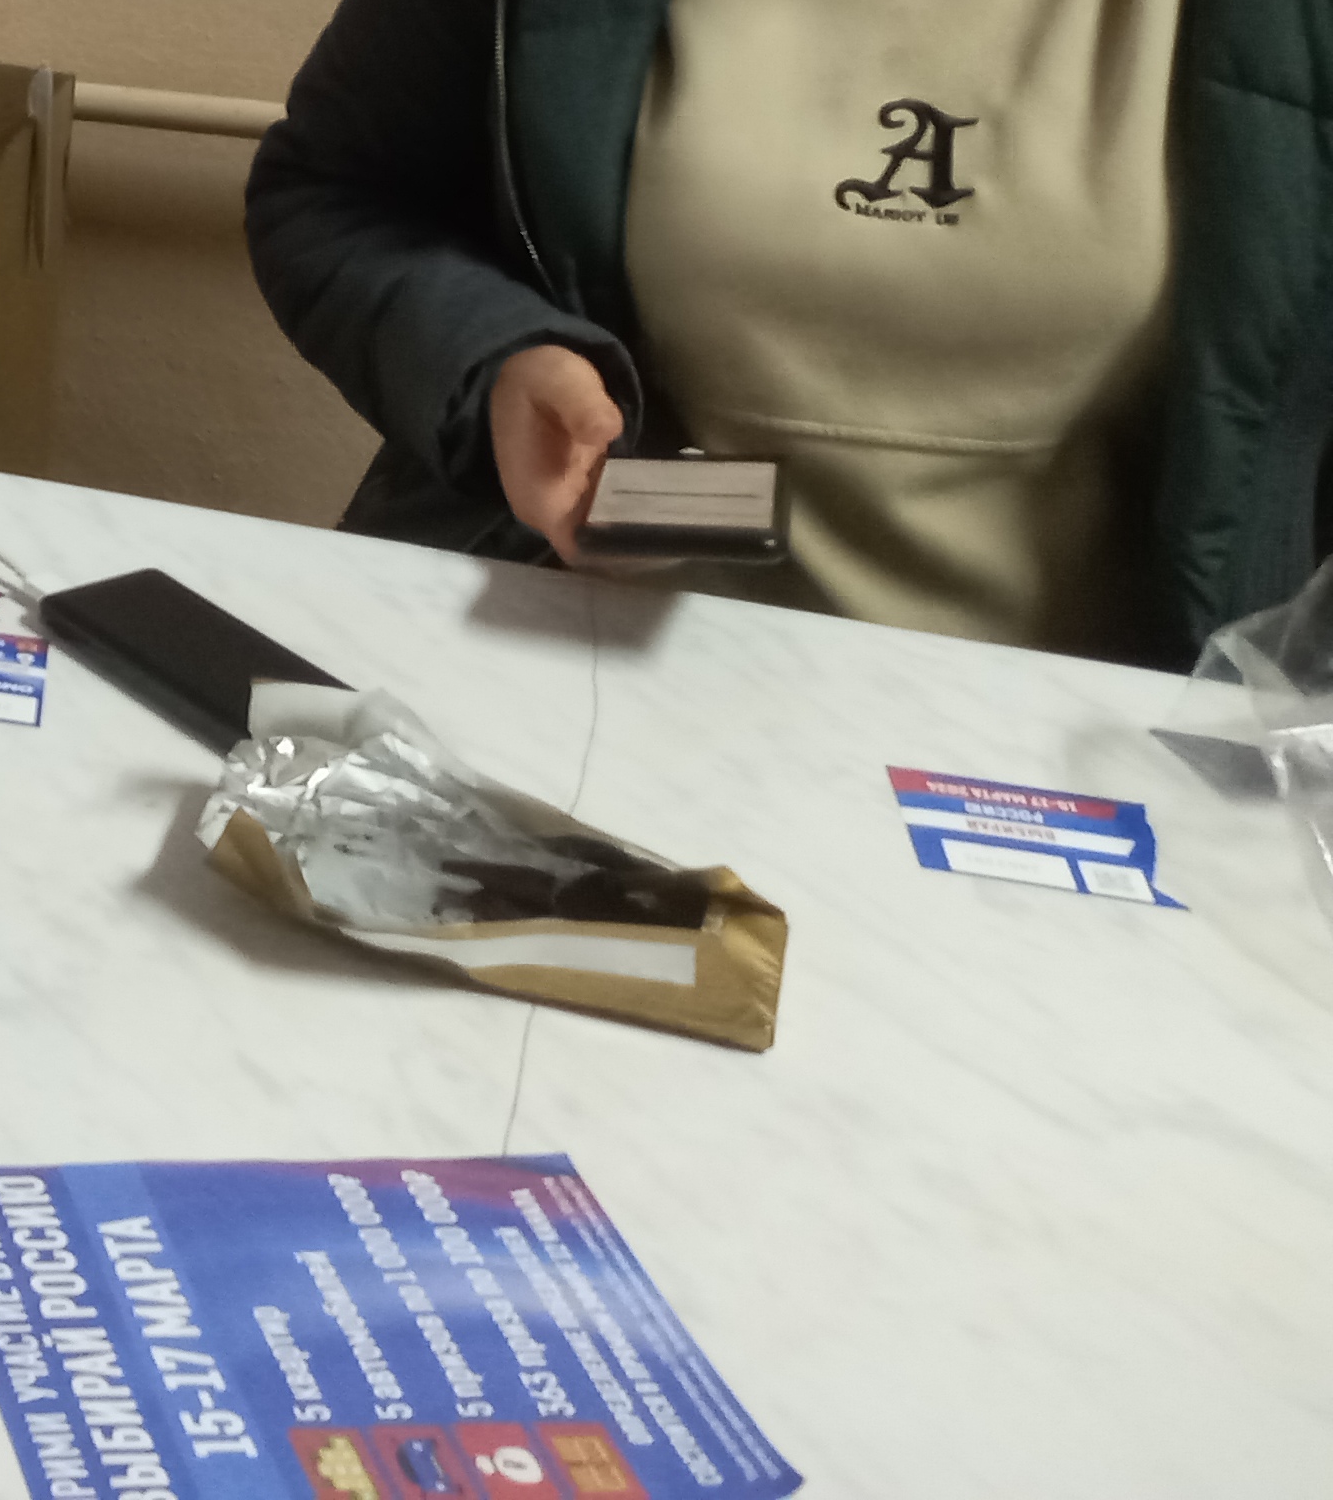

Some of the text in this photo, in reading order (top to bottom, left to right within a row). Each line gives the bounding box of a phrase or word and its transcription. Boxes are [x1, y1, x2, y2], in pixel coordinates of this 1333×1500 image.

[98, 1215, 258, 1458] 15-17 МАРТА
[25, 1412, 97, 1500] РИМИ
